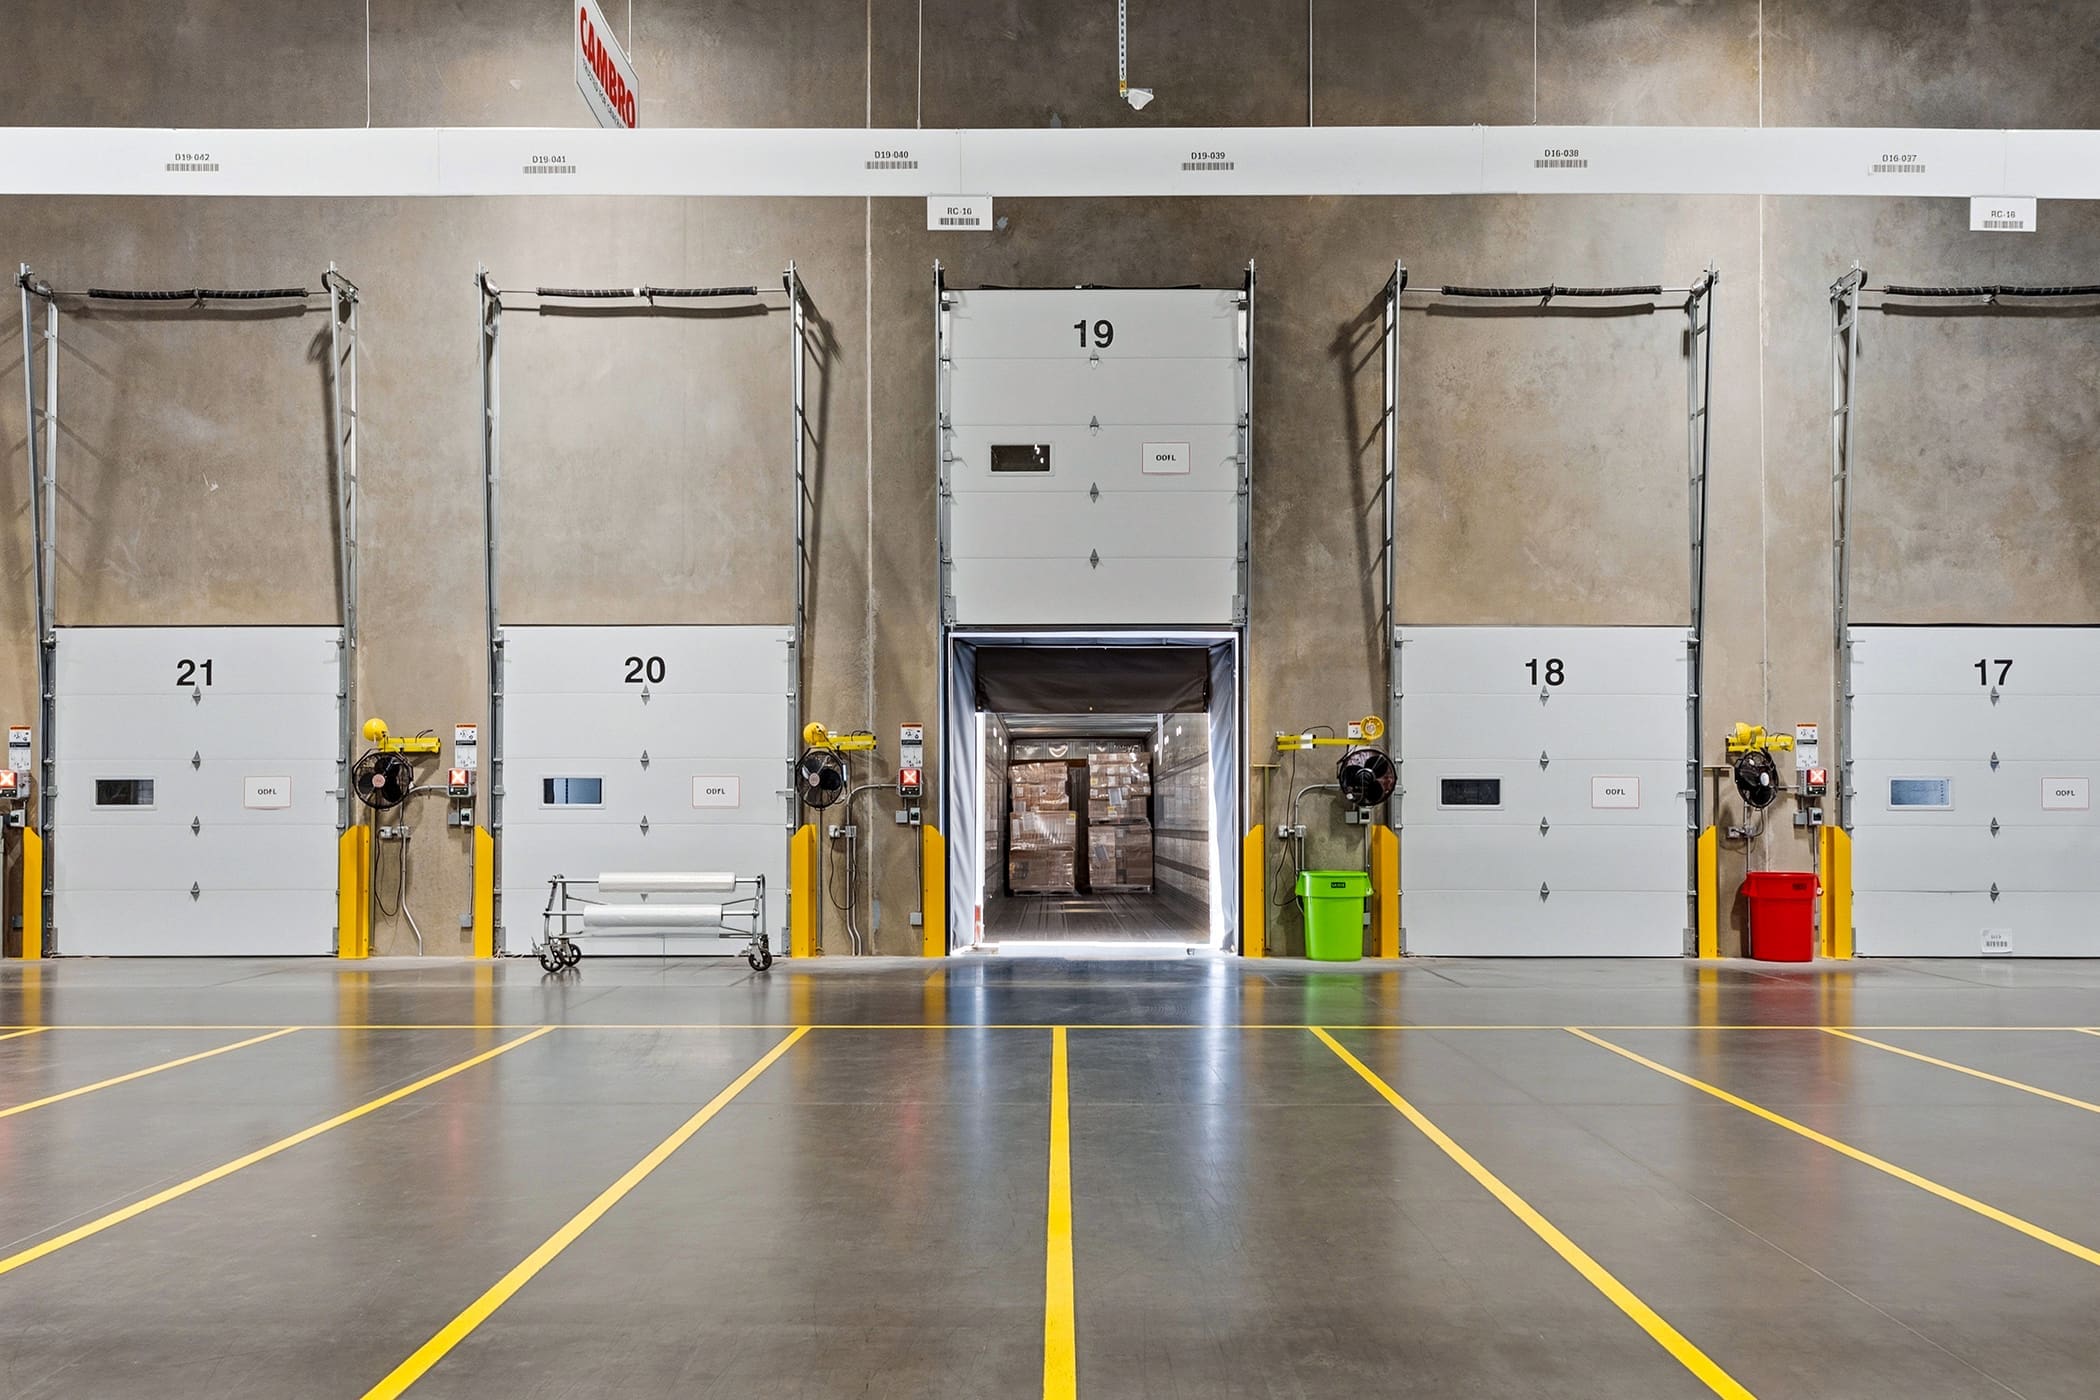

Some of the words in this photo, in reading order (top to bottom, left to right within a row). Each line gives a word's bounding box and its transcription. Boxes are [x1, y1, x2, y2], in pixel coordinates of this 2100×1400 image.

[580, 6, 636, 129] CAMBRO
[875, 150, 909, 158] D19-040
[1191, 152, 1226, 160] D19-039
[1544, 150, 1579, 158] D16-038
[947, 208, 972, 216] RC-16
[1074, 319, 1114, 348] 19
[177, 659, 213, 686] 21
[624, 656, 666, 684] 20
[1526, 659, 1565, 686] 18
[1974, 659, 2014, 686] 17
